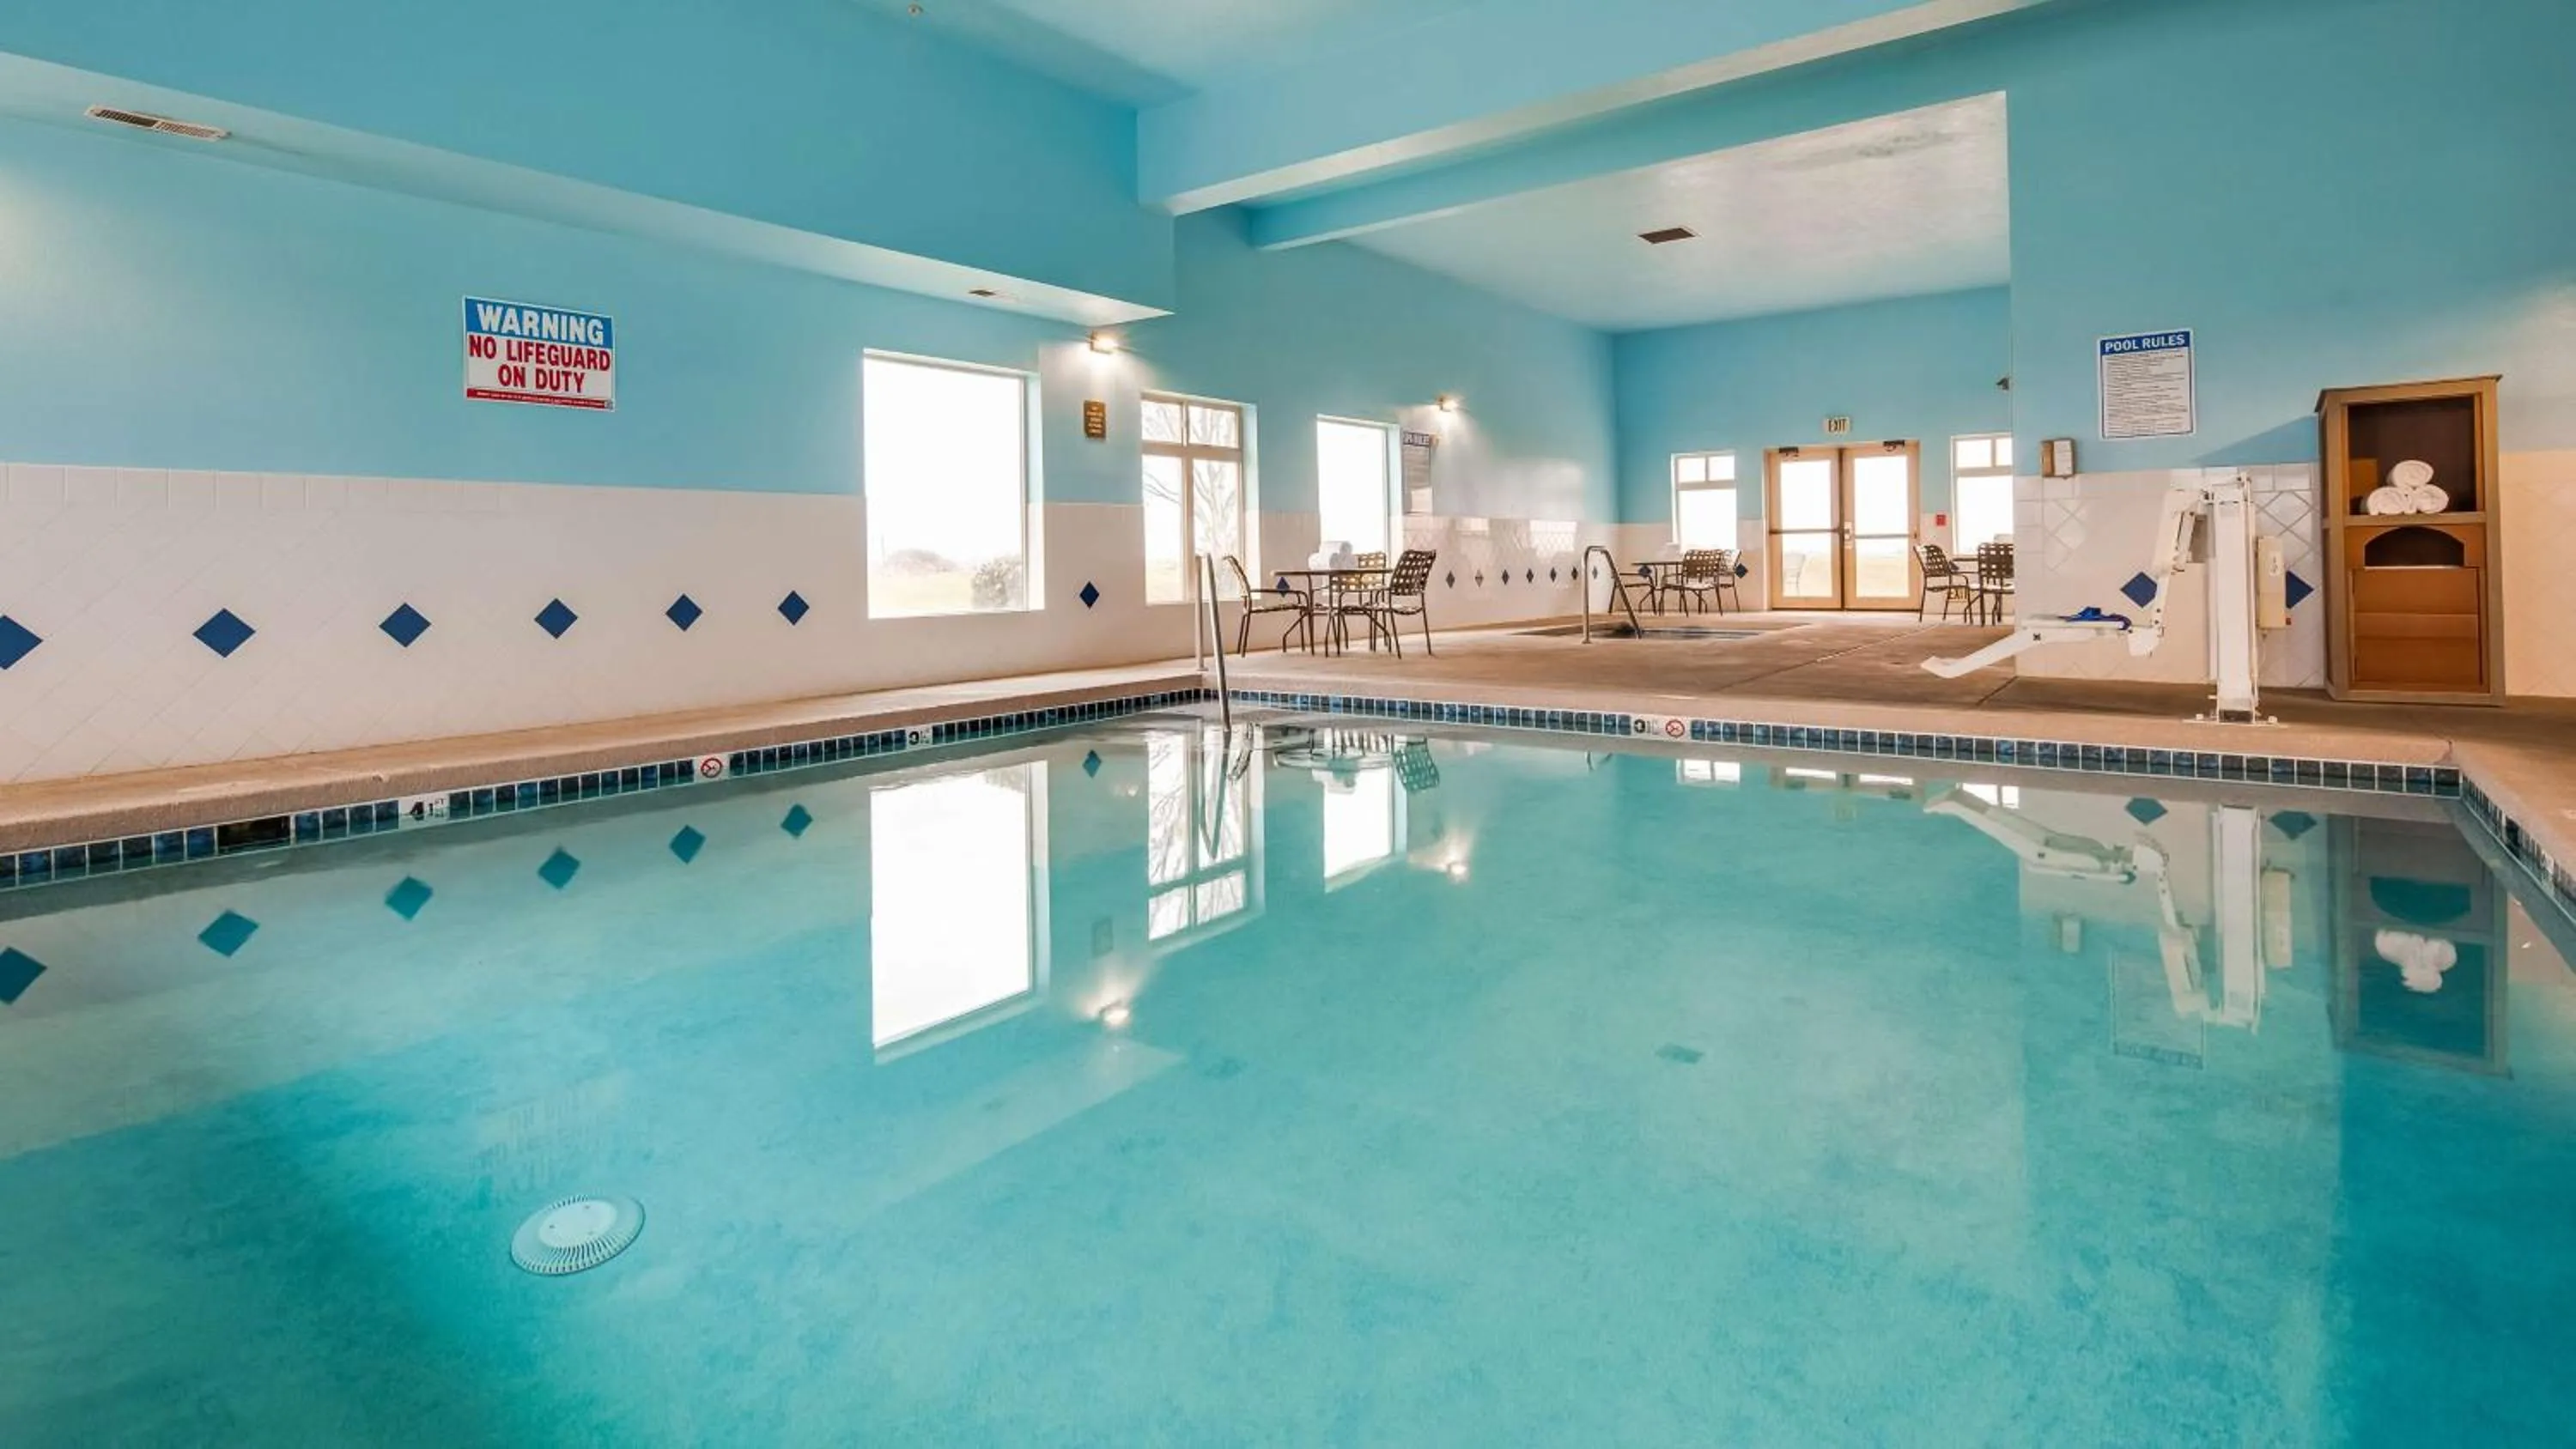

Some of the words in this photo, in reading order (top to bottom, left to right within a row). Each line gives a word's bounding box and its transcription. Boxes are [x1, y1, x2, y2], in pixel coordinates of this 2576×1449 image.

[477, 302, 604, 345] WARNING
[469, 334, 497, 359] NO
[507, 340, 611, 371] LIFEGUARD
[2105, 339, 2139, 353] POOL
[2142, 334, 2185, 349] RULES
[498, 364, 526, 388] ON
[535, 368, 585, 393] DUTY
[1828, 418, 1847, 433] EXIT
